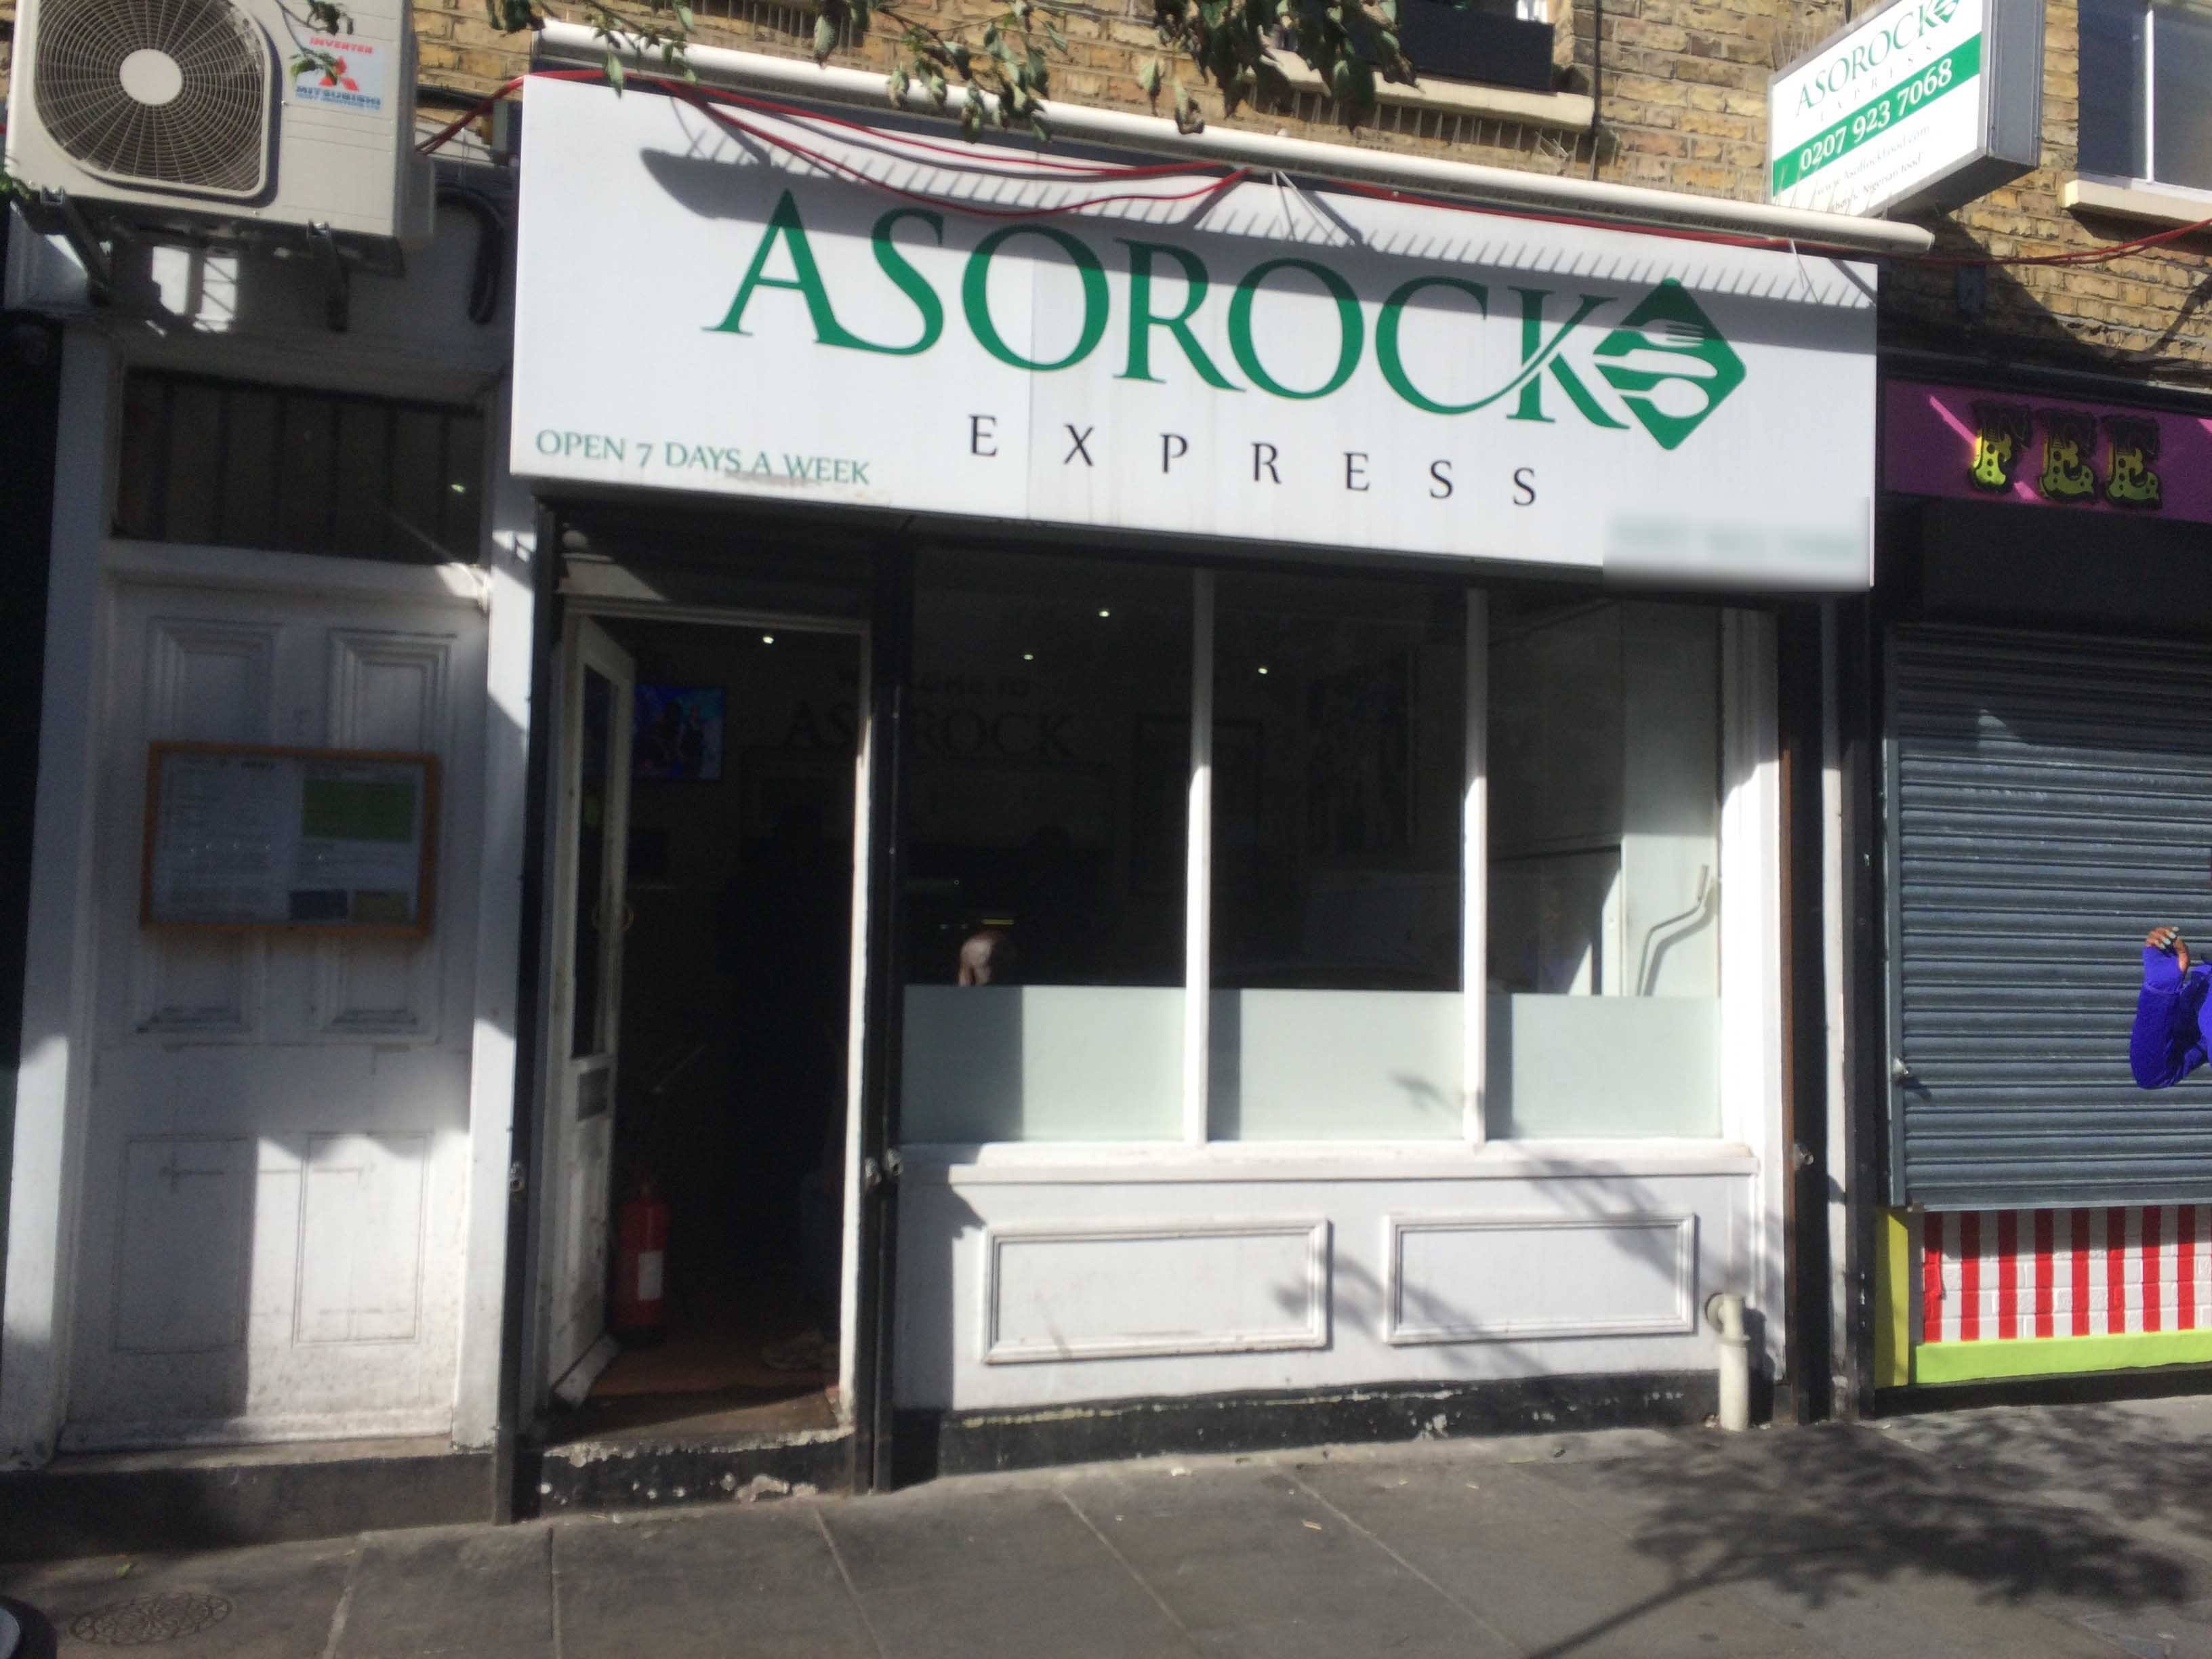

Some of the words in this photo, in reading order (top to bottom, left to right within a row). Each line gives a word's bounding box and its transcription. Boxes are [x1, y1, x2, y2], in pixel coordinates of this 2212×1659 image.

[310, 37, 374, 54] INVERTER
[1796, 0, 1938, 119] ASOROCK
[1800, 126, 1846, 171] 0207
[1853, 100, 1890, 146] 923
[1898, 58, 1952, 116] 7068
[703, 189, 1630, 430] ASOROCK
[535, 429, 626, 461] OPEN
[635, 443, 654, 468] 7
[665, 442, 741, 474] DAYS
[750, 451, 772, 475] A
[783, 453, 870, 485] WEEK
[968, 414, 1536, 506] EXPRESS
[781, 700, 1076, 757] ASROCK
